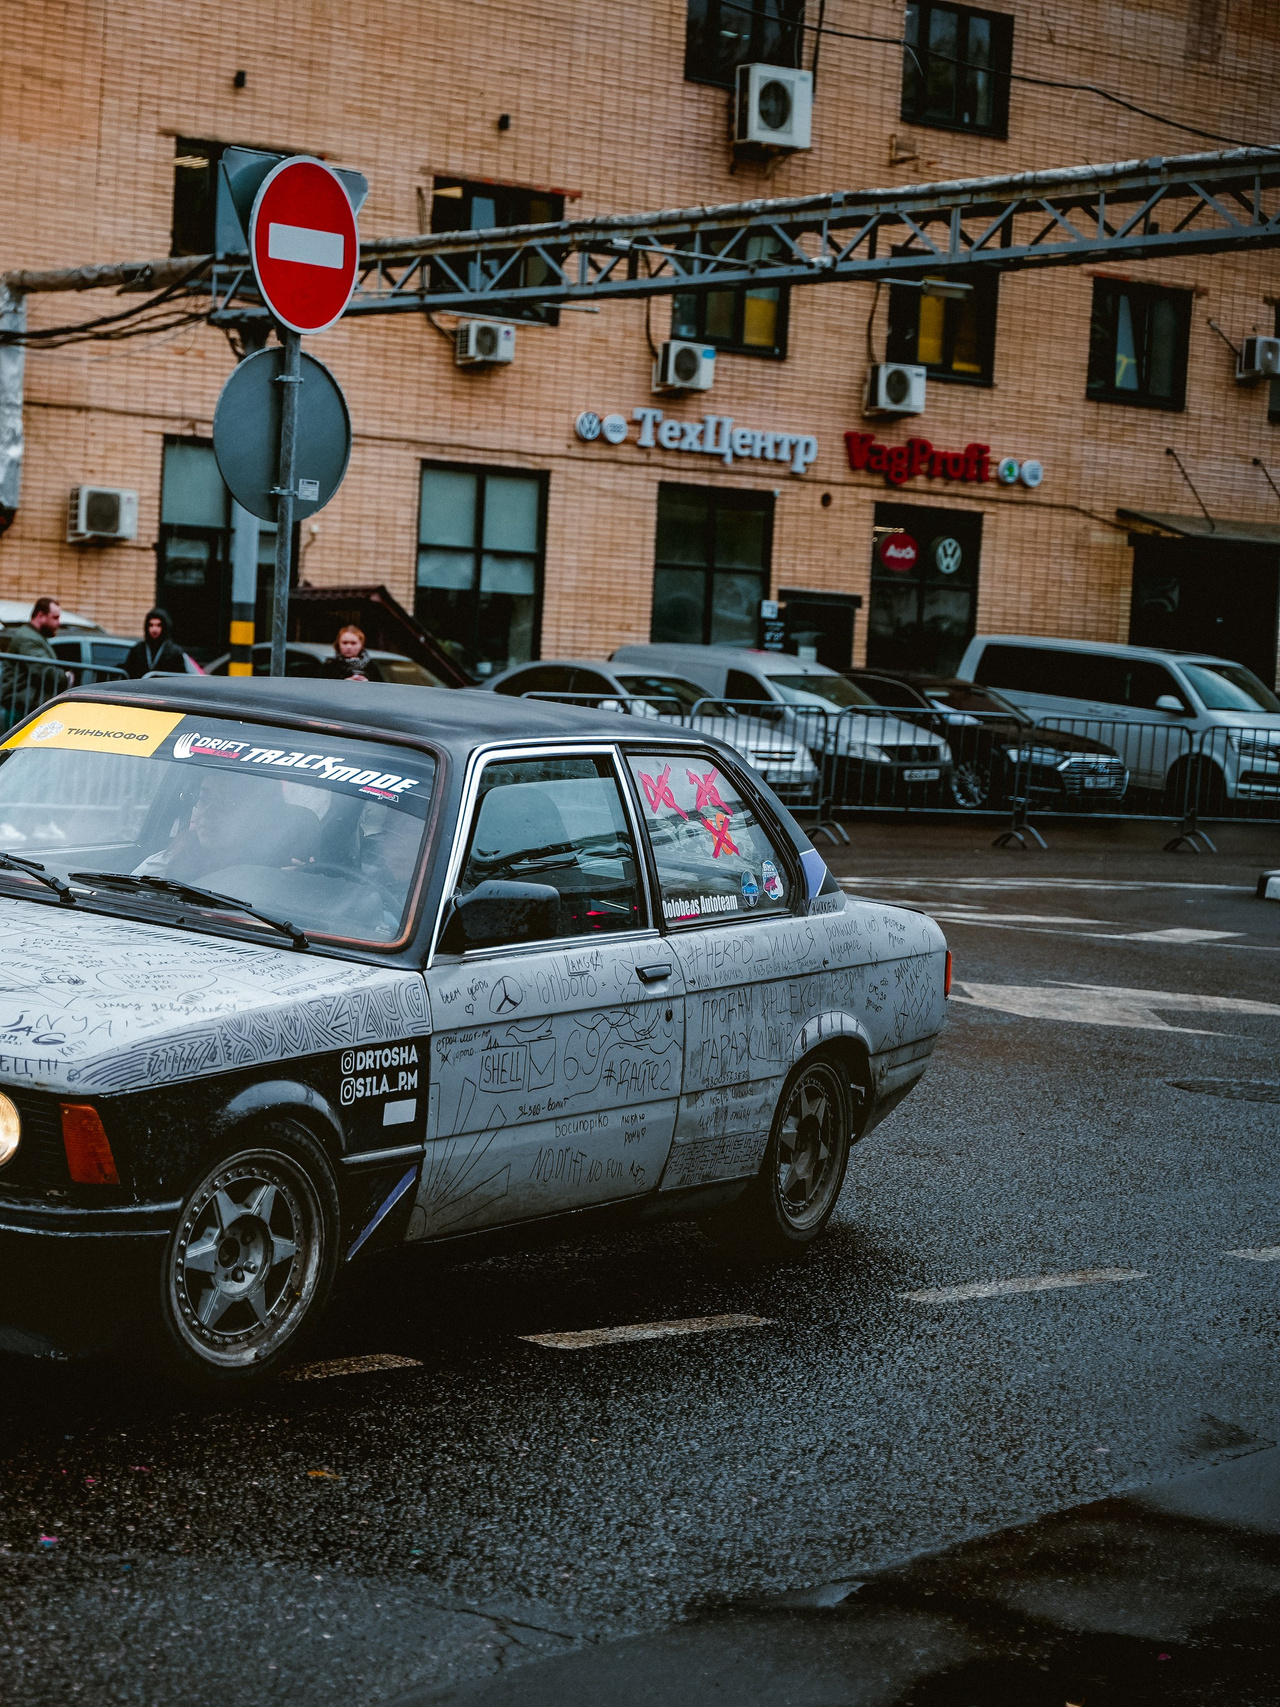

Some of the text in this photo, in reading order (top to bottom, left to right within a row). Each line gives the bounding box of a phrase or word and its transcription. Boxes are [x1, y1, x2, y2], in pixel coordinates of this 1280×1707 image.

[632, 406, 819, 474] ТехЦентр
[844, 430, 992, 485] VagProfi
[65, 725, 150, 743] ТИНЬКОФФ
[194, 736, 251, 753] DRIFT
[700, 894, 739, 914] Autoteam
[356, 1044, 419, 1071] DRTOSHA
[483, 1051, 522, 1085] SHELL
